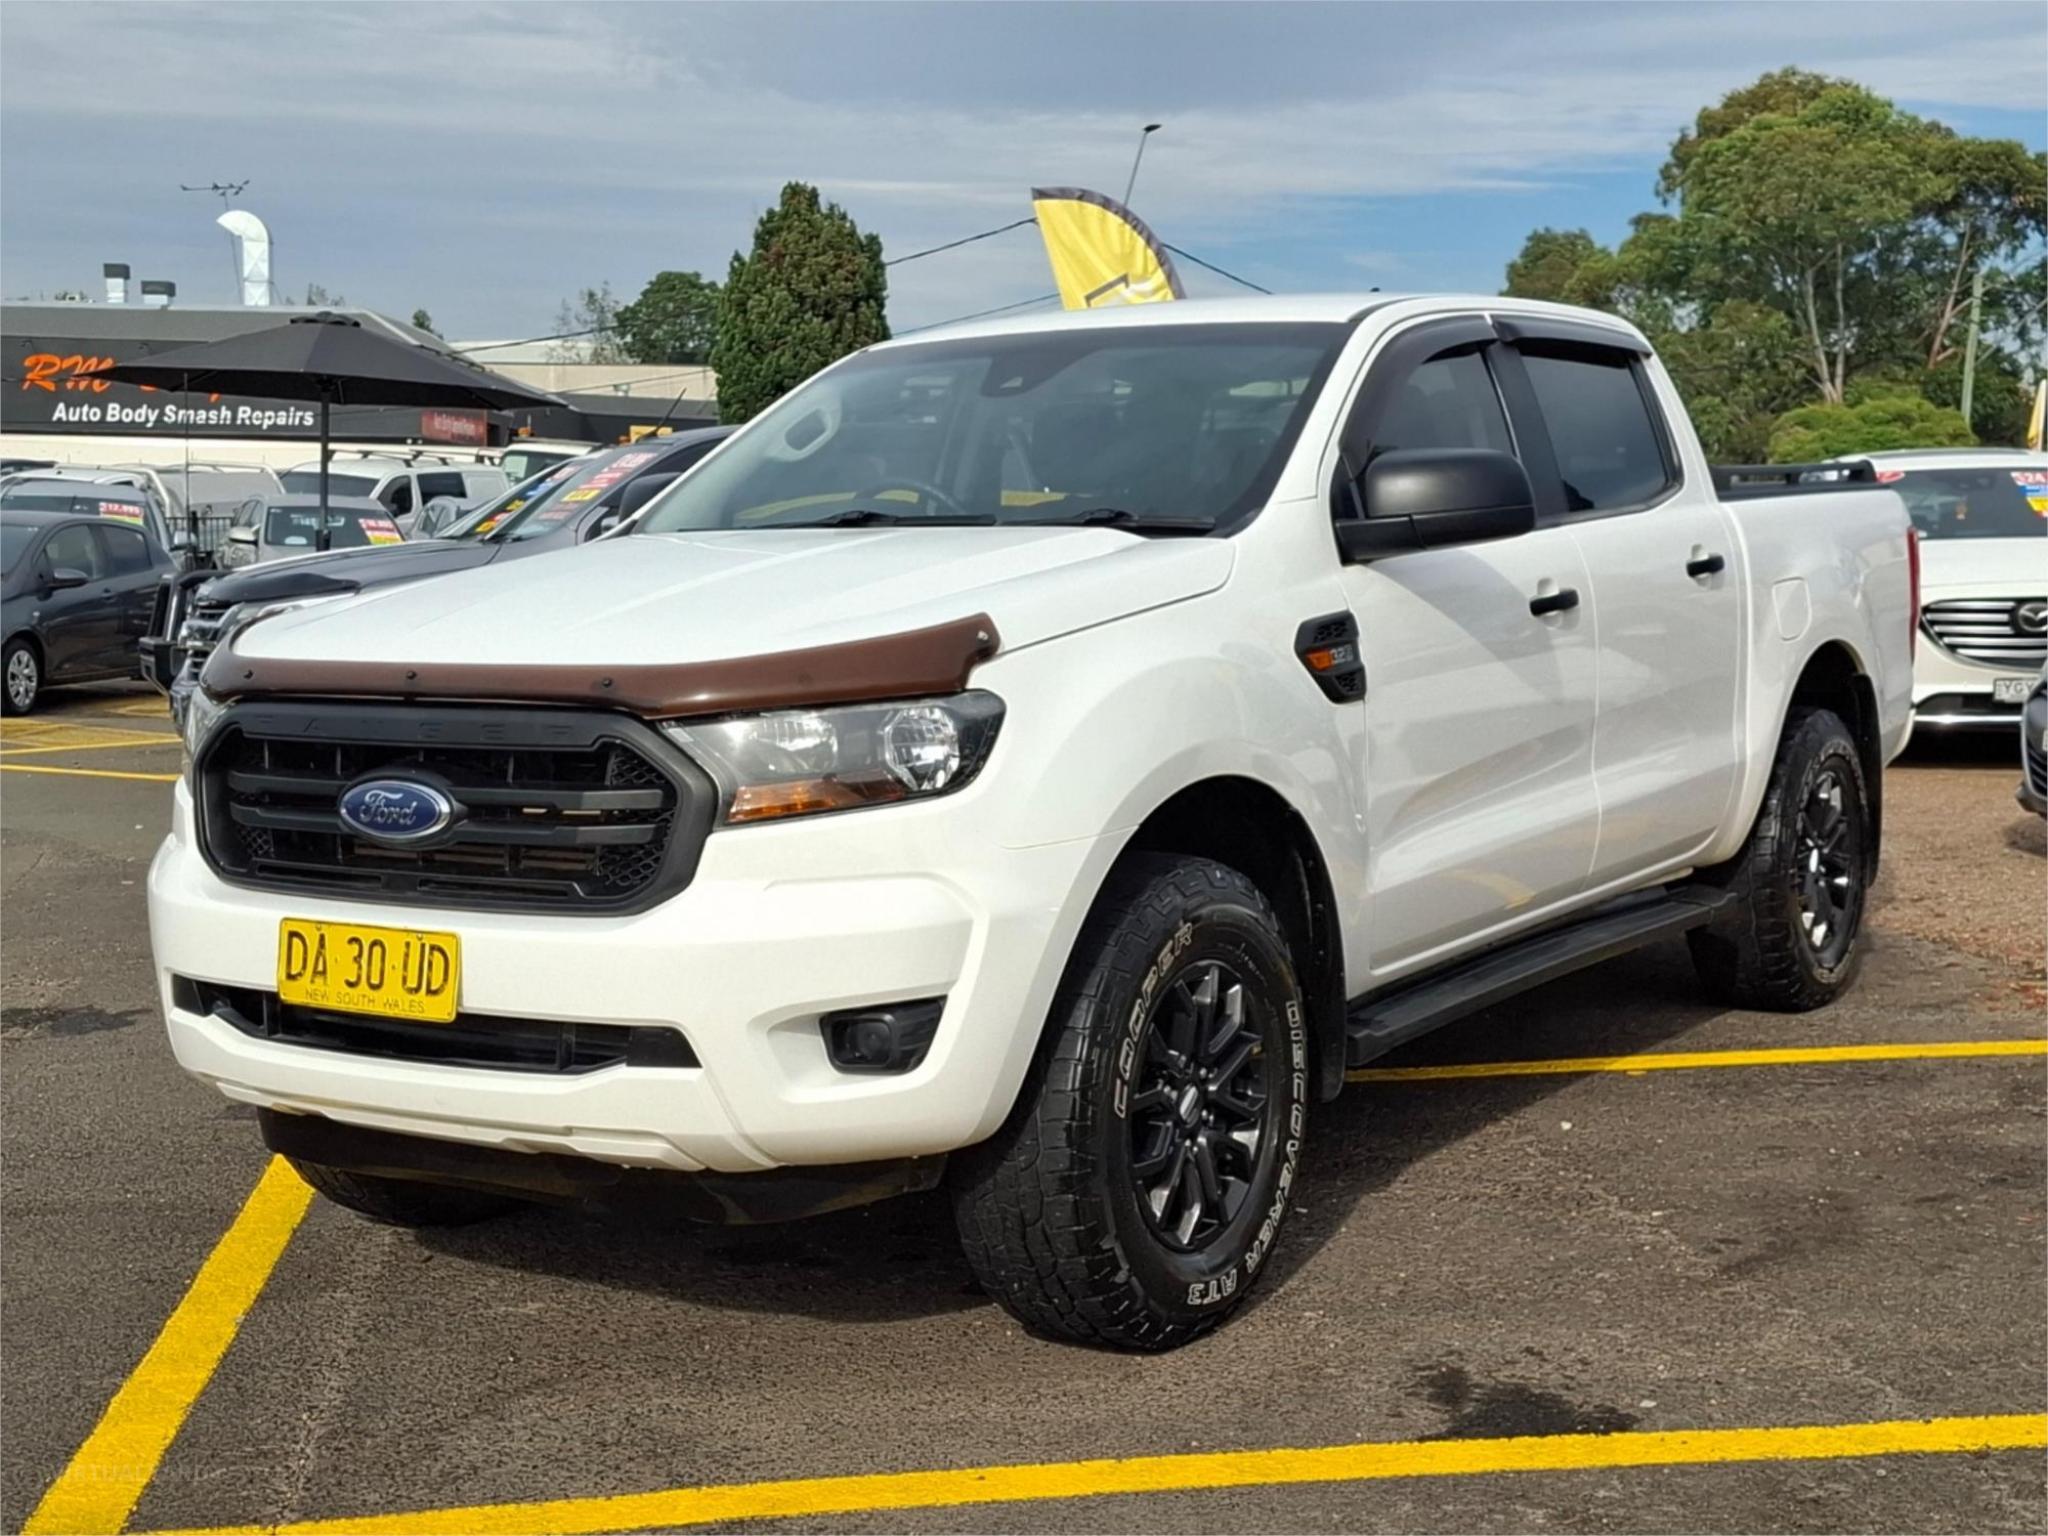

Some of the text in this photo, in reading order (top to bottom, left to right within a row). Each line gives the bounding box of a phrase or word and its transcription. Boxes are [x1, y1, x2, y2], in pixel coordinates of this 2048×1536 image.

[52, 402, 315, 430] Auto Body Smash Repairs
[360, 789, 417, 825] Ford
[285, 930, 450, 997] DA 30 UD
[305, 989, 426, 1014] NEW SOUTH WALES
[1114, 921, 1193, 1119] COOPER
[1246, 1000, 1307, 1273] DISCOVERER
